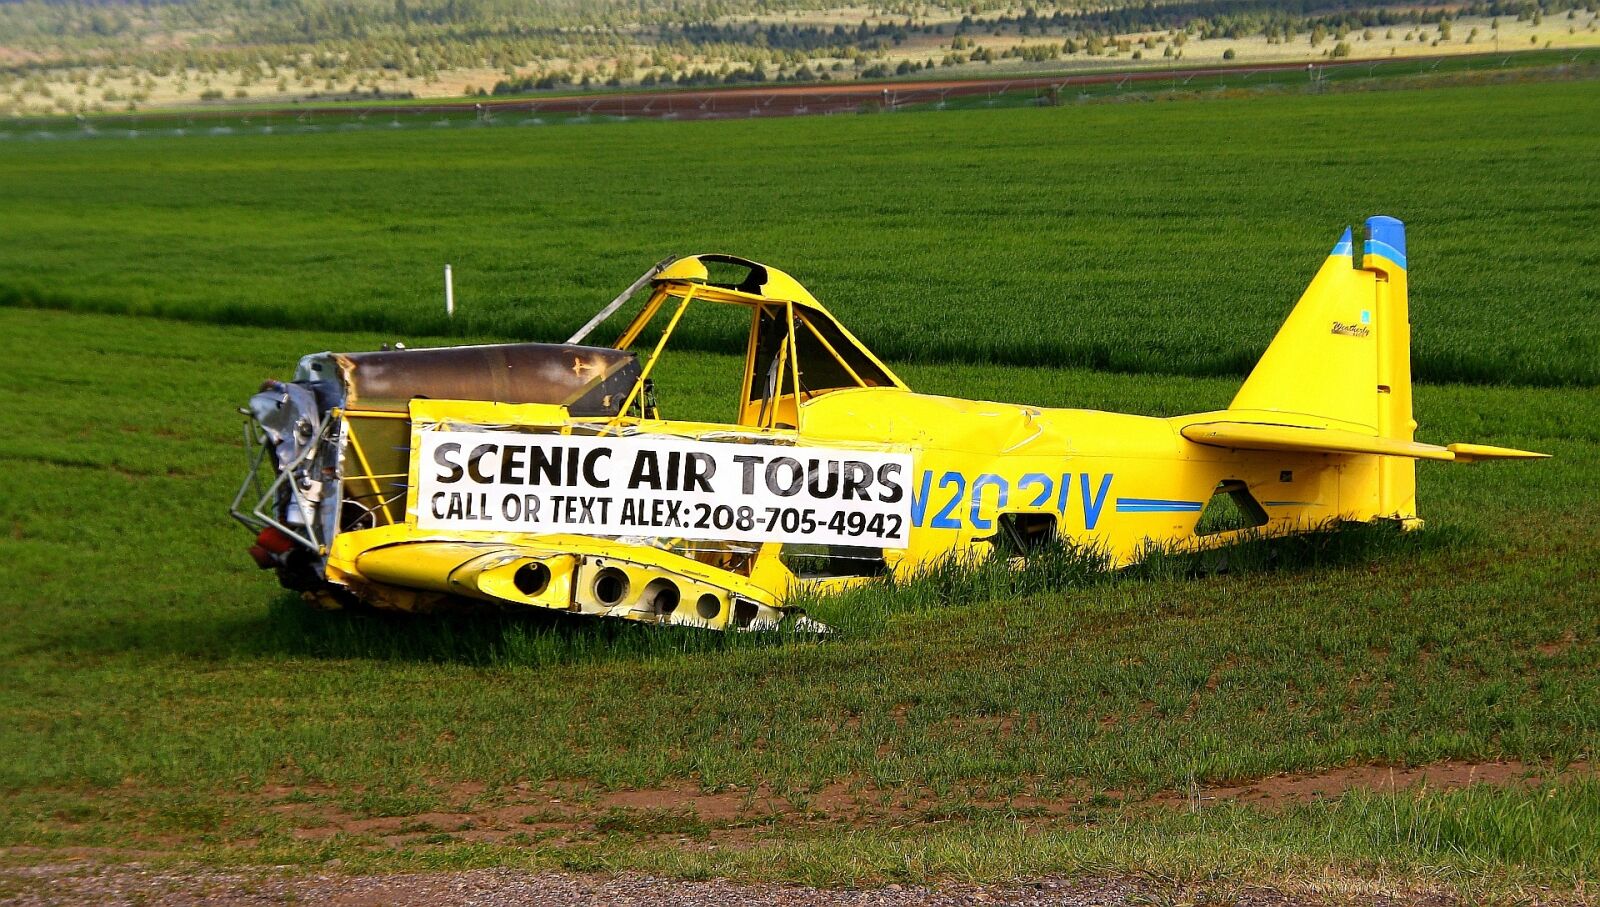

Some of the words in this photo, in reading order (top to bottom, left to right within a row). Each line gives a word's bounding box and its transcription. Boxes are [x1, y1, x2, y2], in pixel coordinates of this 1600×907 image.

[433, 442, 612, 488] SCENIC
[627, 449, 716, 493] AIR
[733, 454, 903, 503] TOURS
[431, 491, 492, 520] CALL
[501, 493, 541, 522] OR
[550, 495, 613, 525] TEXT
